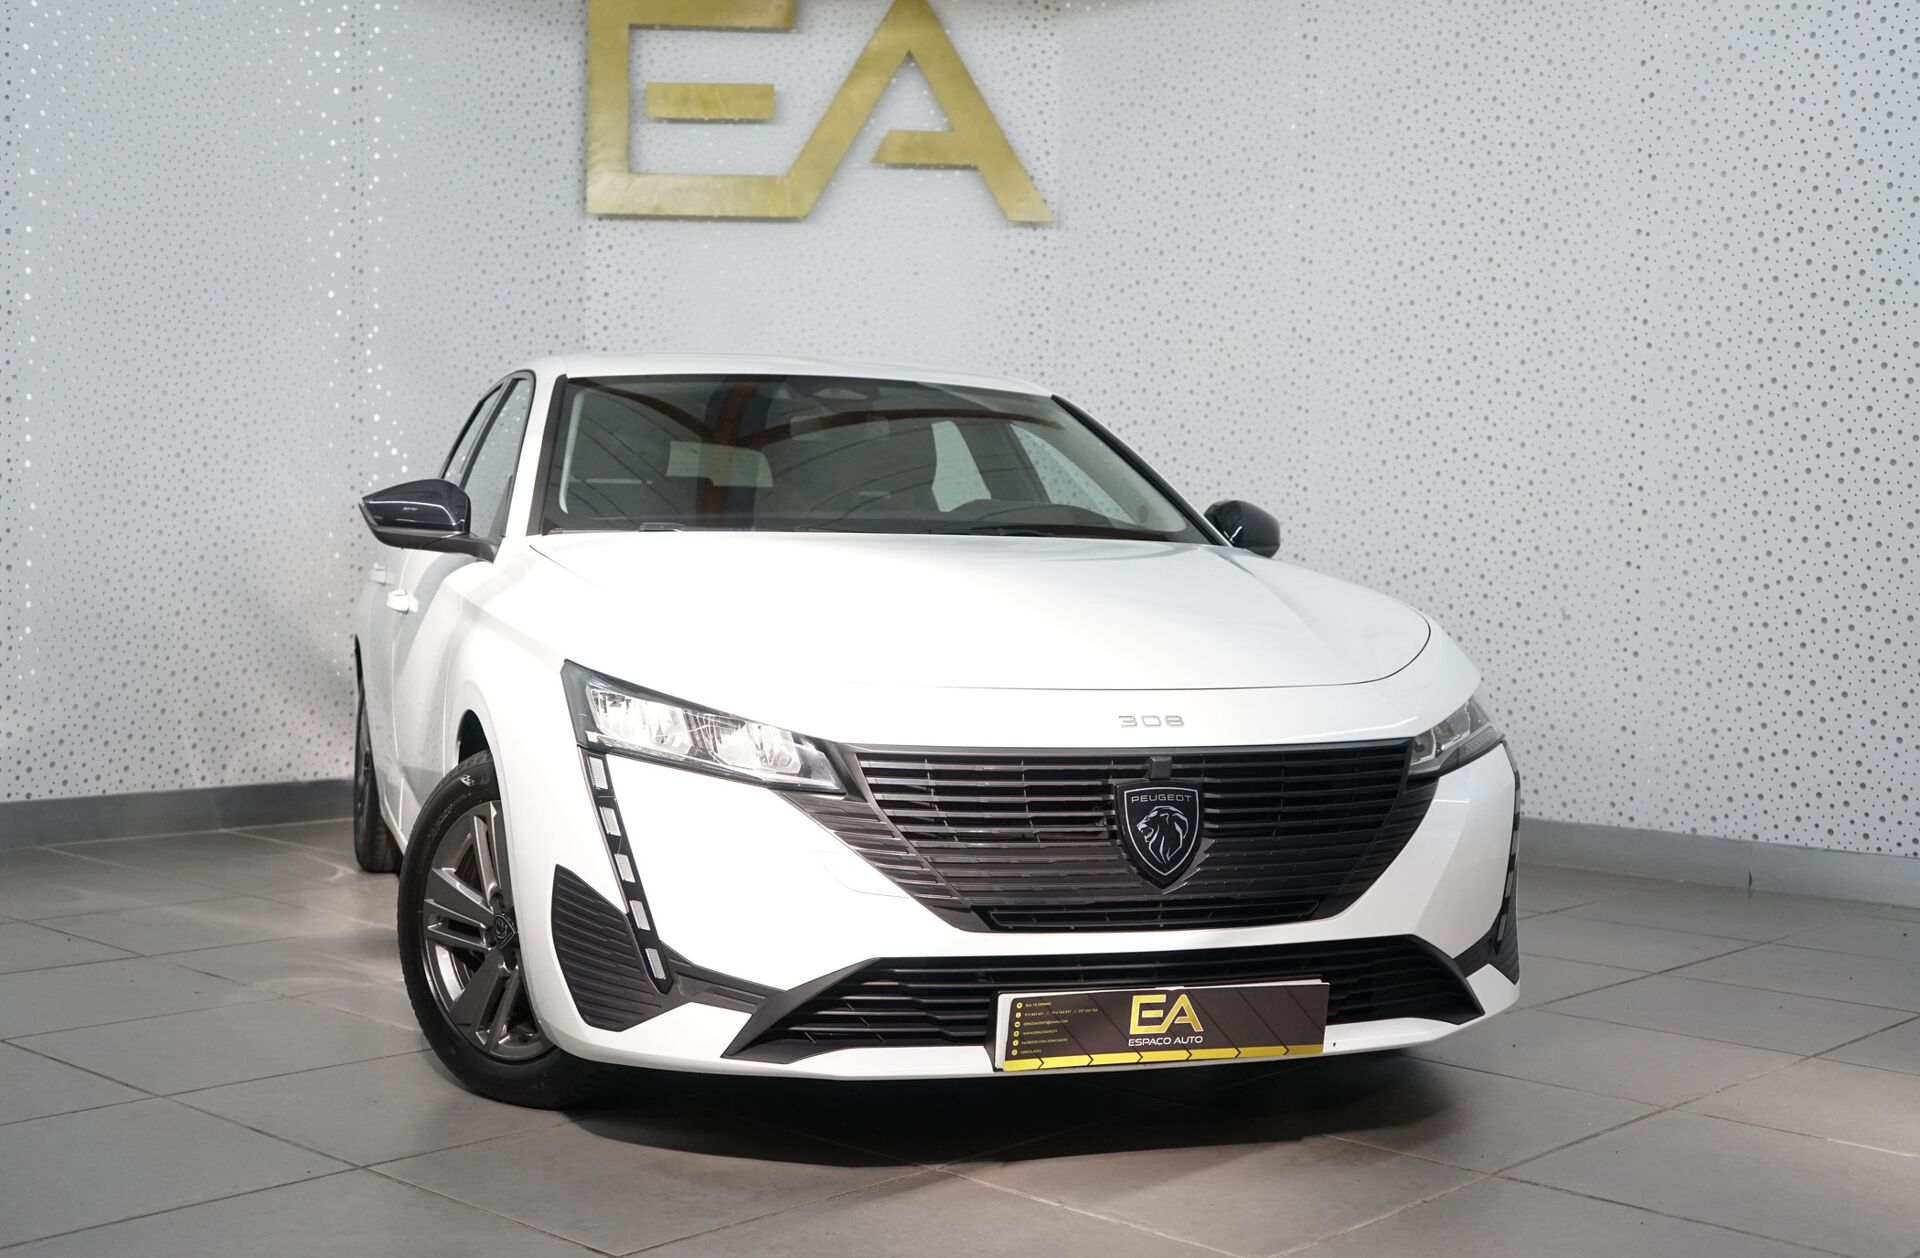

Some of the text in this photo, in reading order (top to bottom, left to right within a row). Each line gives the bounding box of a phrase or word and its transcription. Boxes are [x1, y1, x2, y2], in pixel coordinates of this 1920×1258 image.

[586, 0, 1055, 222] EA
[1118, 715, 1185, 728] 308
[1131, 793, 1193, 804] PEUGEOT
[1129, 993, 1204, 1035] EA
[1173, 1035, 1204, 1045] AUTO
